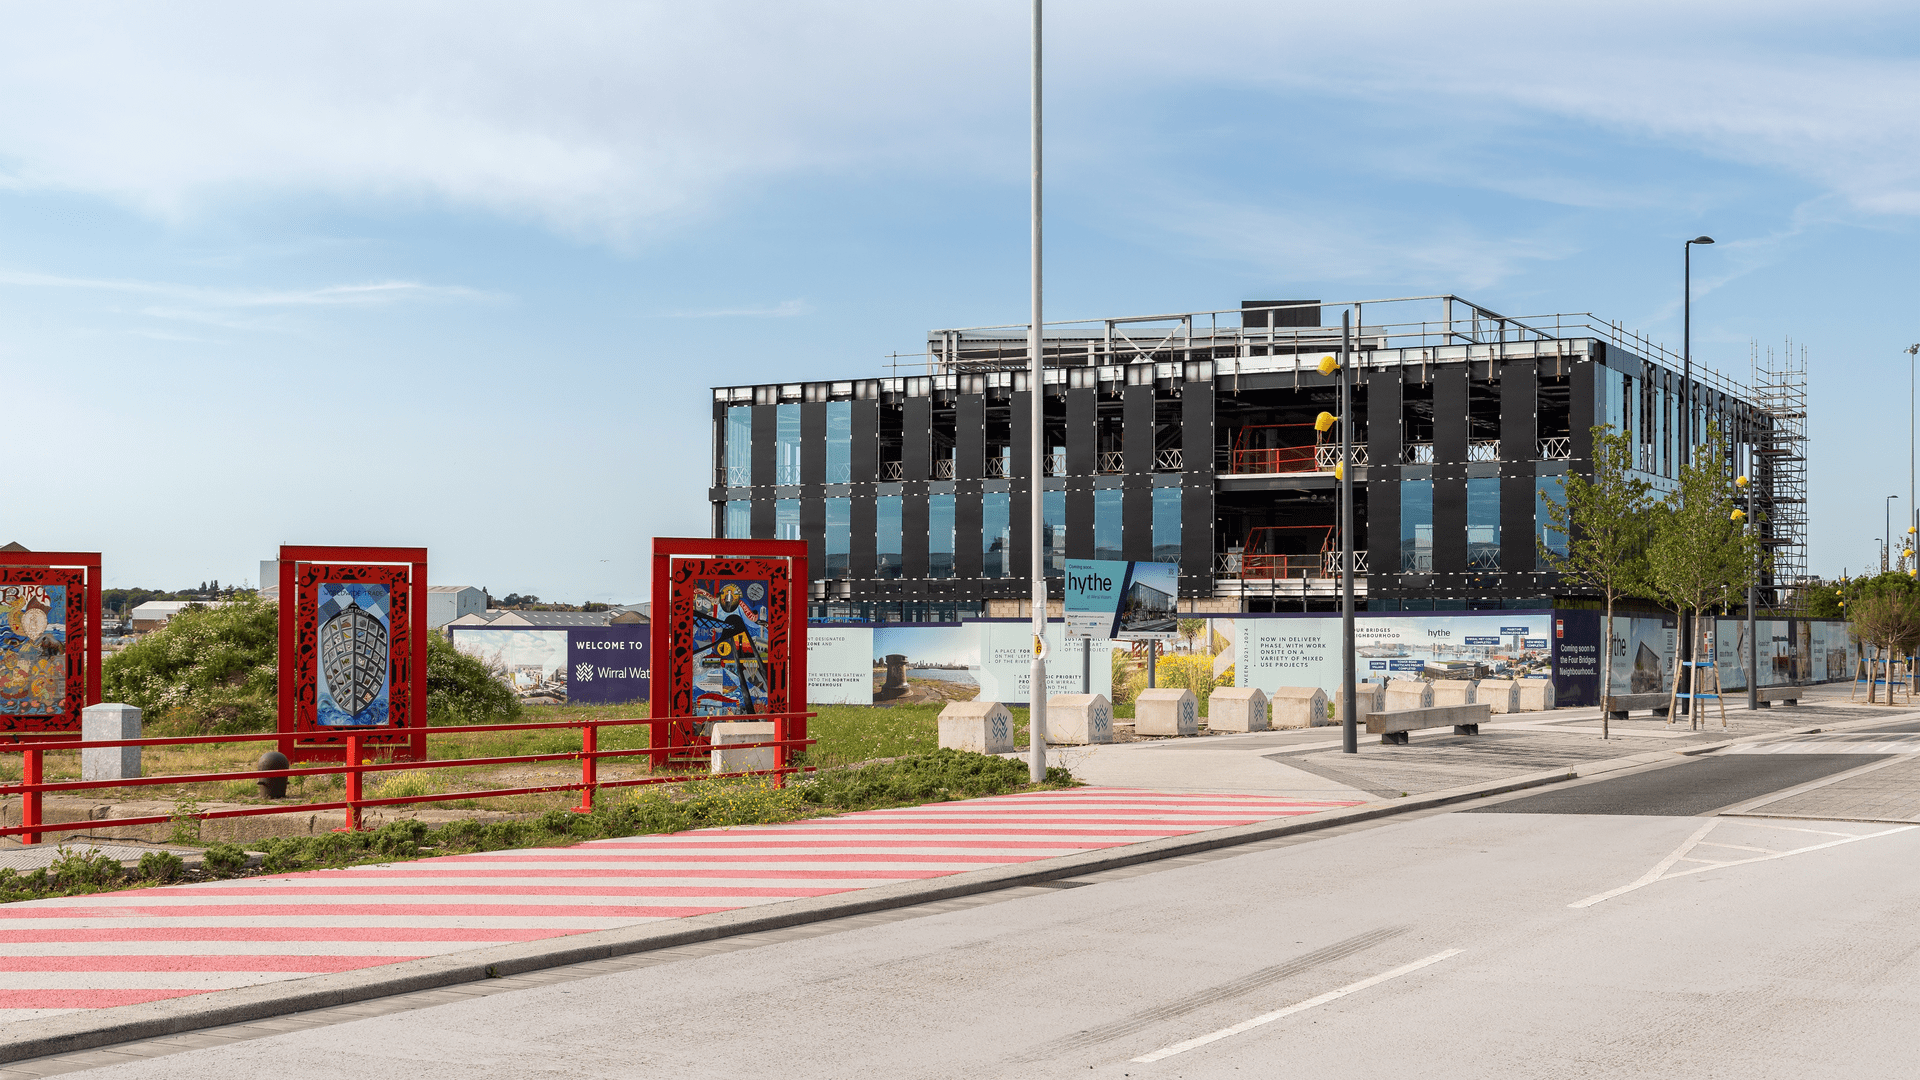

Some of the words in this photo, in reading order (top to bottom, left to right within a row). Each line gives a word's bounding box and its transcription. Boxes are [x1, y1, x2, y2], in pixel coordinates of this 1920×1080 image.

[1068, 572, 1112, 595] hythe
[1427, 629, 1450, 638] hythe
[576, 641, 624, 650] WELCOME
[629, 641, 643, 650] TO
[1560, 643, 1578, 653] Coming
[1590, 644, 1596, 652] to
[1579, 656, 1596, 665] Bridges
[597, 666, 627, 679] Wirral
[627, 667, 650, 679] Wat
